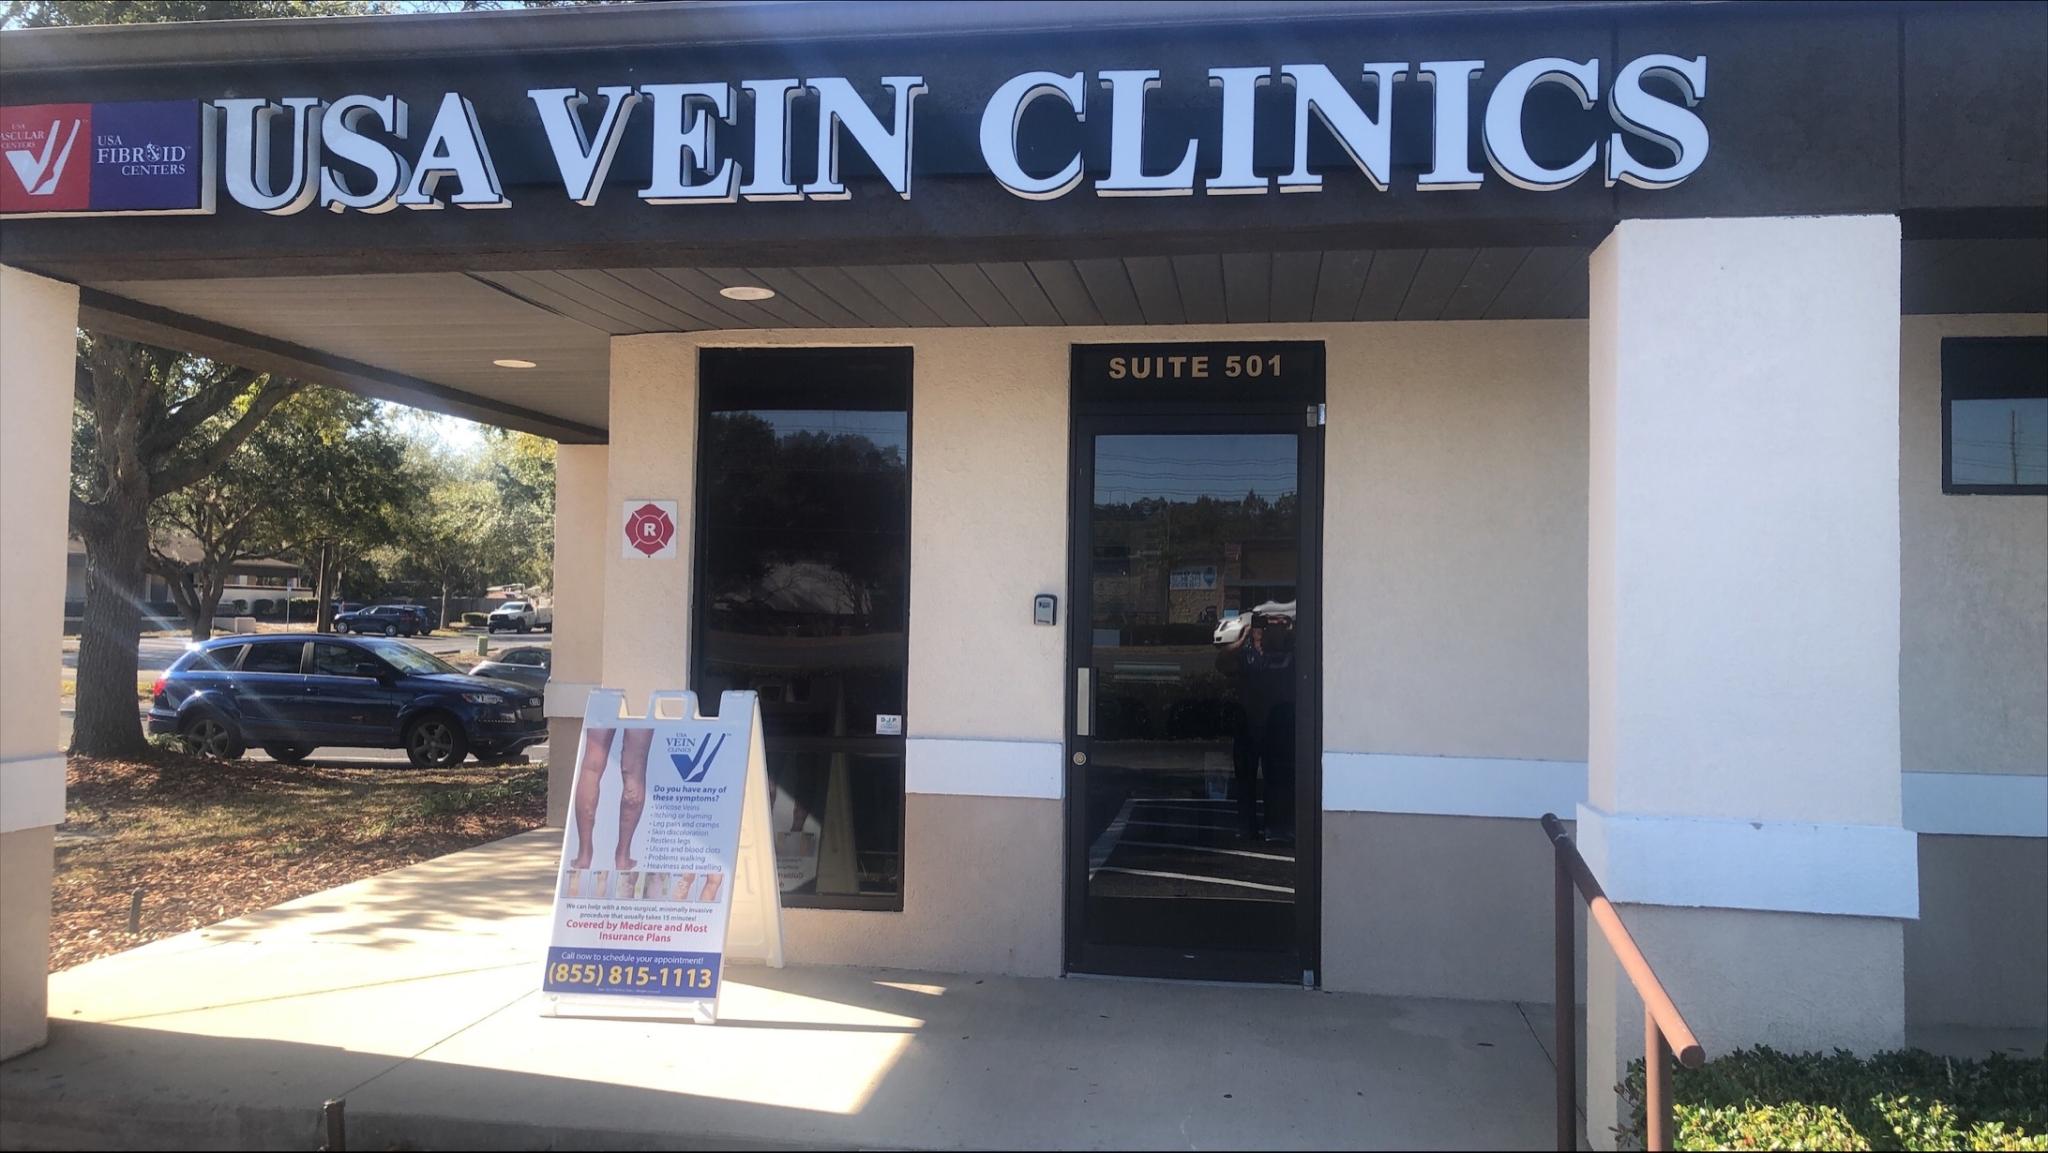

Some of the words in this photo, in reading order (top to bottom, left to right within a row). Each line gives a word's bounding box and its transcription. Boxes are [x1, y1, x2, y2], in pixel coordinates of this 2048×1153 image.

[0, 130, 45, 140] ASCULAR
[214, 92, 508, 213] USA
[527, 76, 925, 203] VEIN
[980, 54, 1711, 198] CLINICS
[97, 135, 122, 146] USA
[121, 164, 186, 176] CENTERS
[1109, 357, 1209, 379] SUITE
[1225, 355, 1281, 377] 501
[644, 523, 656, 536] R
[666, 738, 695, 747] VEIN
[676, 795, 720, 803] symptoms?
[680, 855, 706, 863] walking
[647, 862, 679, 870] Heaviness
[695, 864, 721, 872] swelling
[566, 920, 604, 929] Covered
[607, 921, 618, 931] by
[620, 921, 662, 931] Medicare
[664, 923, 682, 932] and
[685, 924, 707, 933] Most
[599, 932, 644, 941] Insurance
[646, 933, 671, 942] Plans
[561, 951, 575, 960] Call
[654, 957, 704, 965] appointment!
[549, 962, 604, 986] (855)
[609, 965, 712, 988] 815-1113
